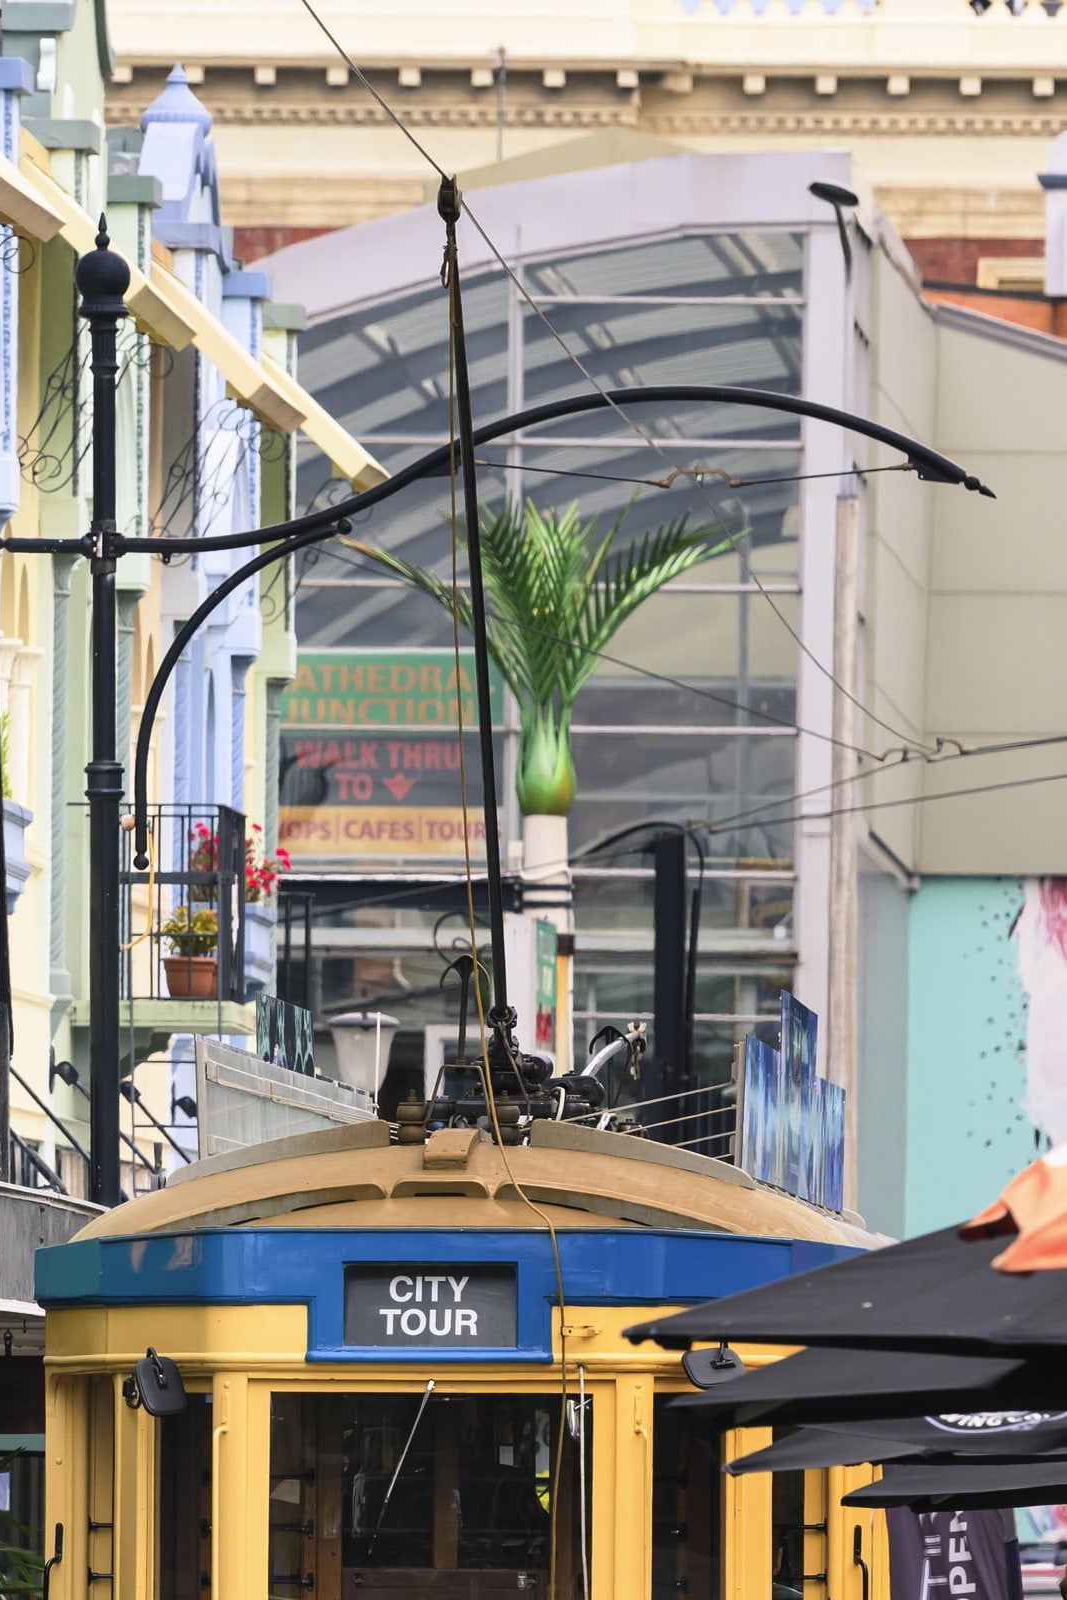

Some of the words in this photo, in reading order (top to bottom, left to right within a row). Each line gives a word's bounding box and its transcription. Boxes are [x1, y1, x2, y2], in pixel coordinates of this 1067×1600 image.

[283, 664, 495, 694] ATHEDRA
[287, 697, 474, 725] JUNCTION
[294, 741, 379, 769] WALK
[386, 741, 462, 770] THRU
[335, 773, 374, 800] TO
[344, 820, 414, 841] CAFES
[389, 1275, 470, 1303] CITY
[379, 1308, 479, 1336] TOUR
